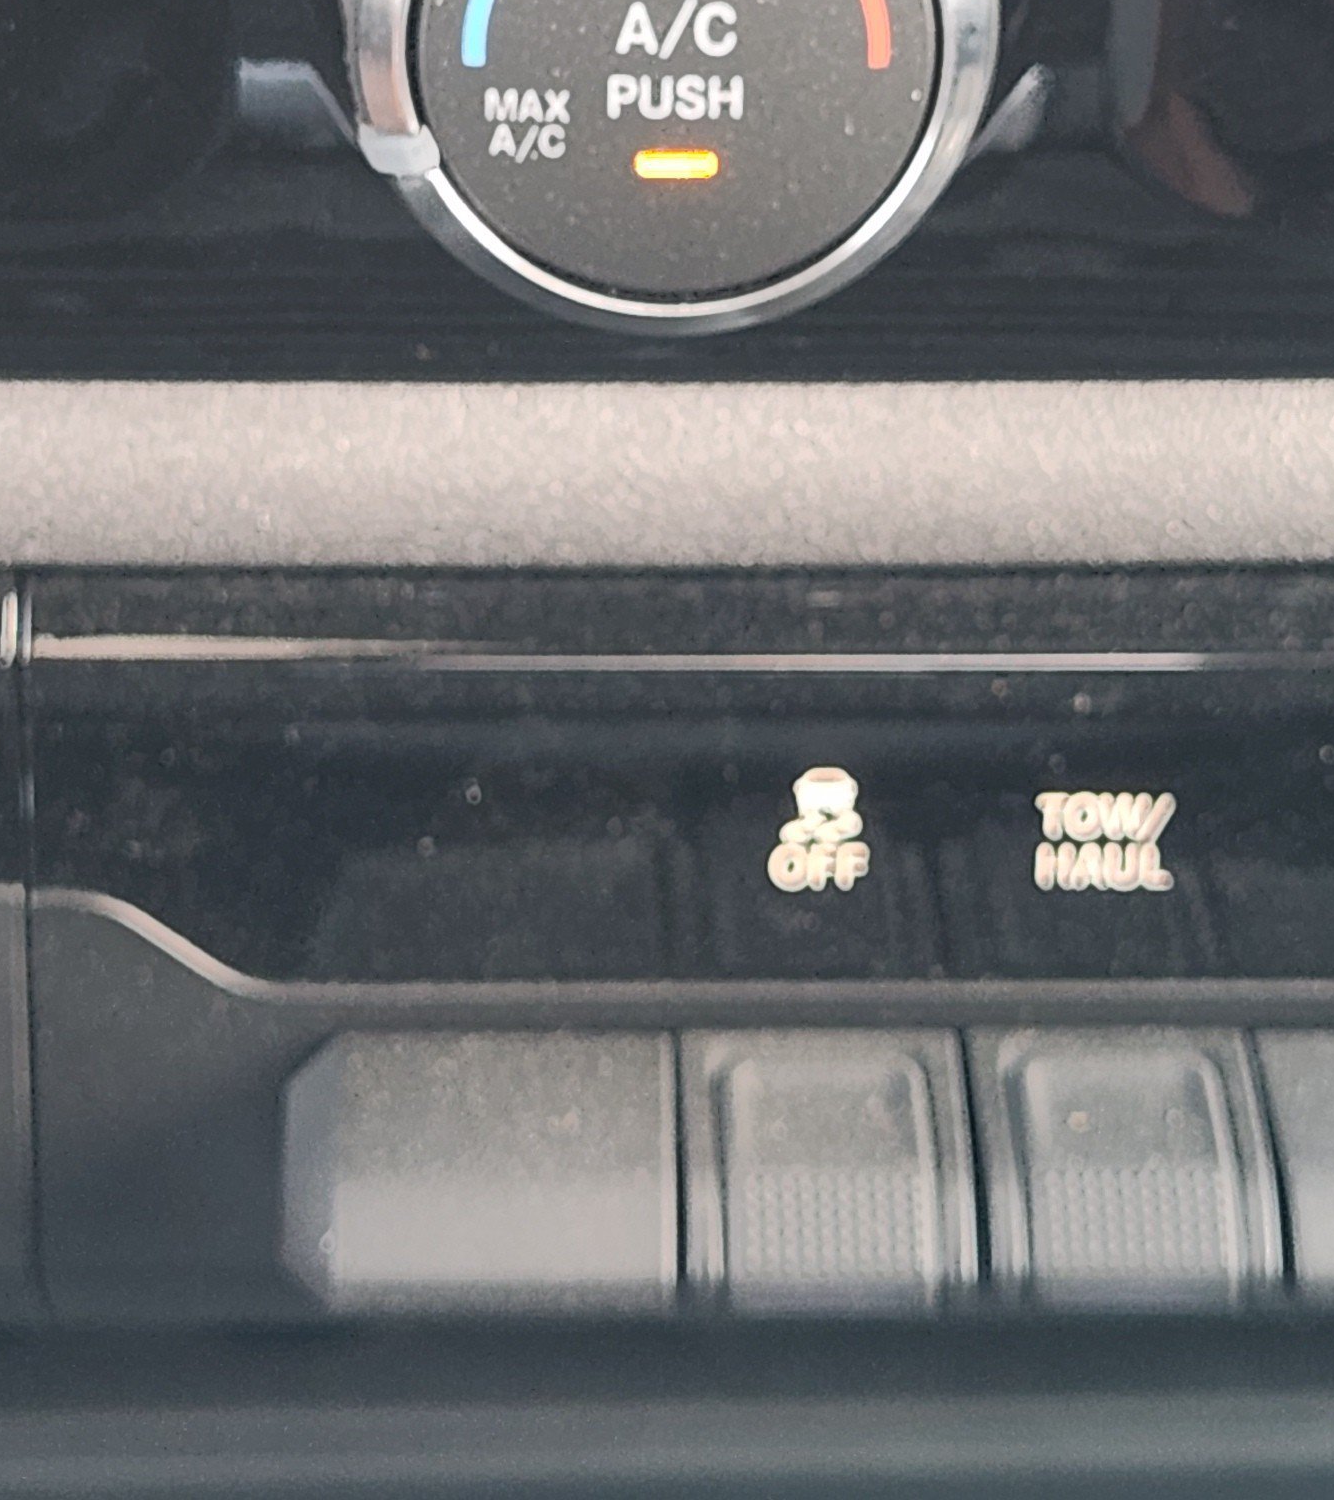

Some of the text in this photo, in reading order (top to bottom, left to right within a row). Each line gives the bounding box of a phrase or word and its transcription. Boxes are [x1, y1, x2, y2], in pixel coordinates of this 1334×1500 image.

[483, 87, 571, 125] MAX
[606, 73, 744, 121] PUSH
[487, 124, 566, 164] A/C
[1034, 790, 1178, 843] TOW/
[767, 840, 871, 893] OFF
[1034, 840, 1175, 892] HAUL
